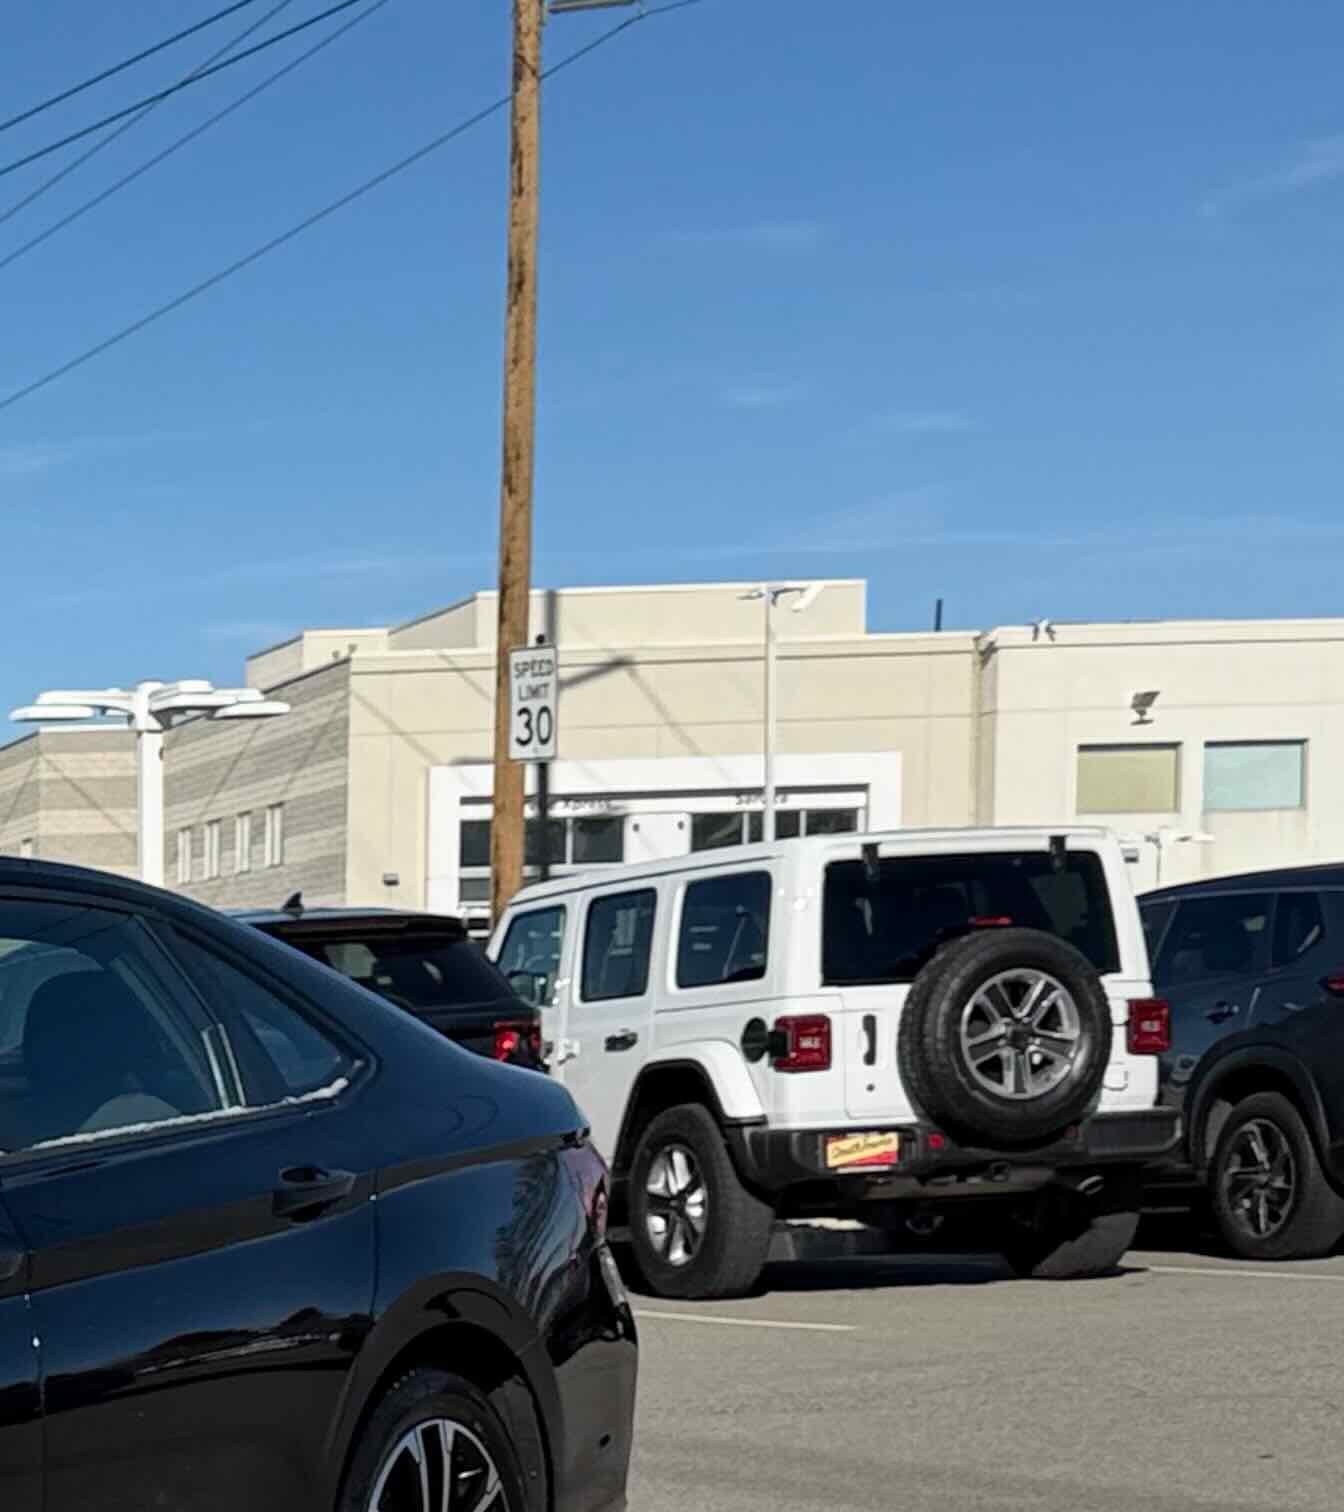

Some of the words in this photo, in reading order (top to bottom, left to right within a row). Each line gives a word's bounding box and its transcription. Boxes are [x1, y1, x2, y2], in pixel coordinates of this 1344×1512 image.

[514, 658, 553, 679] SPEED
[518, 682, 549, 701] LIMIT
[515, 705, 553, 746] 30
